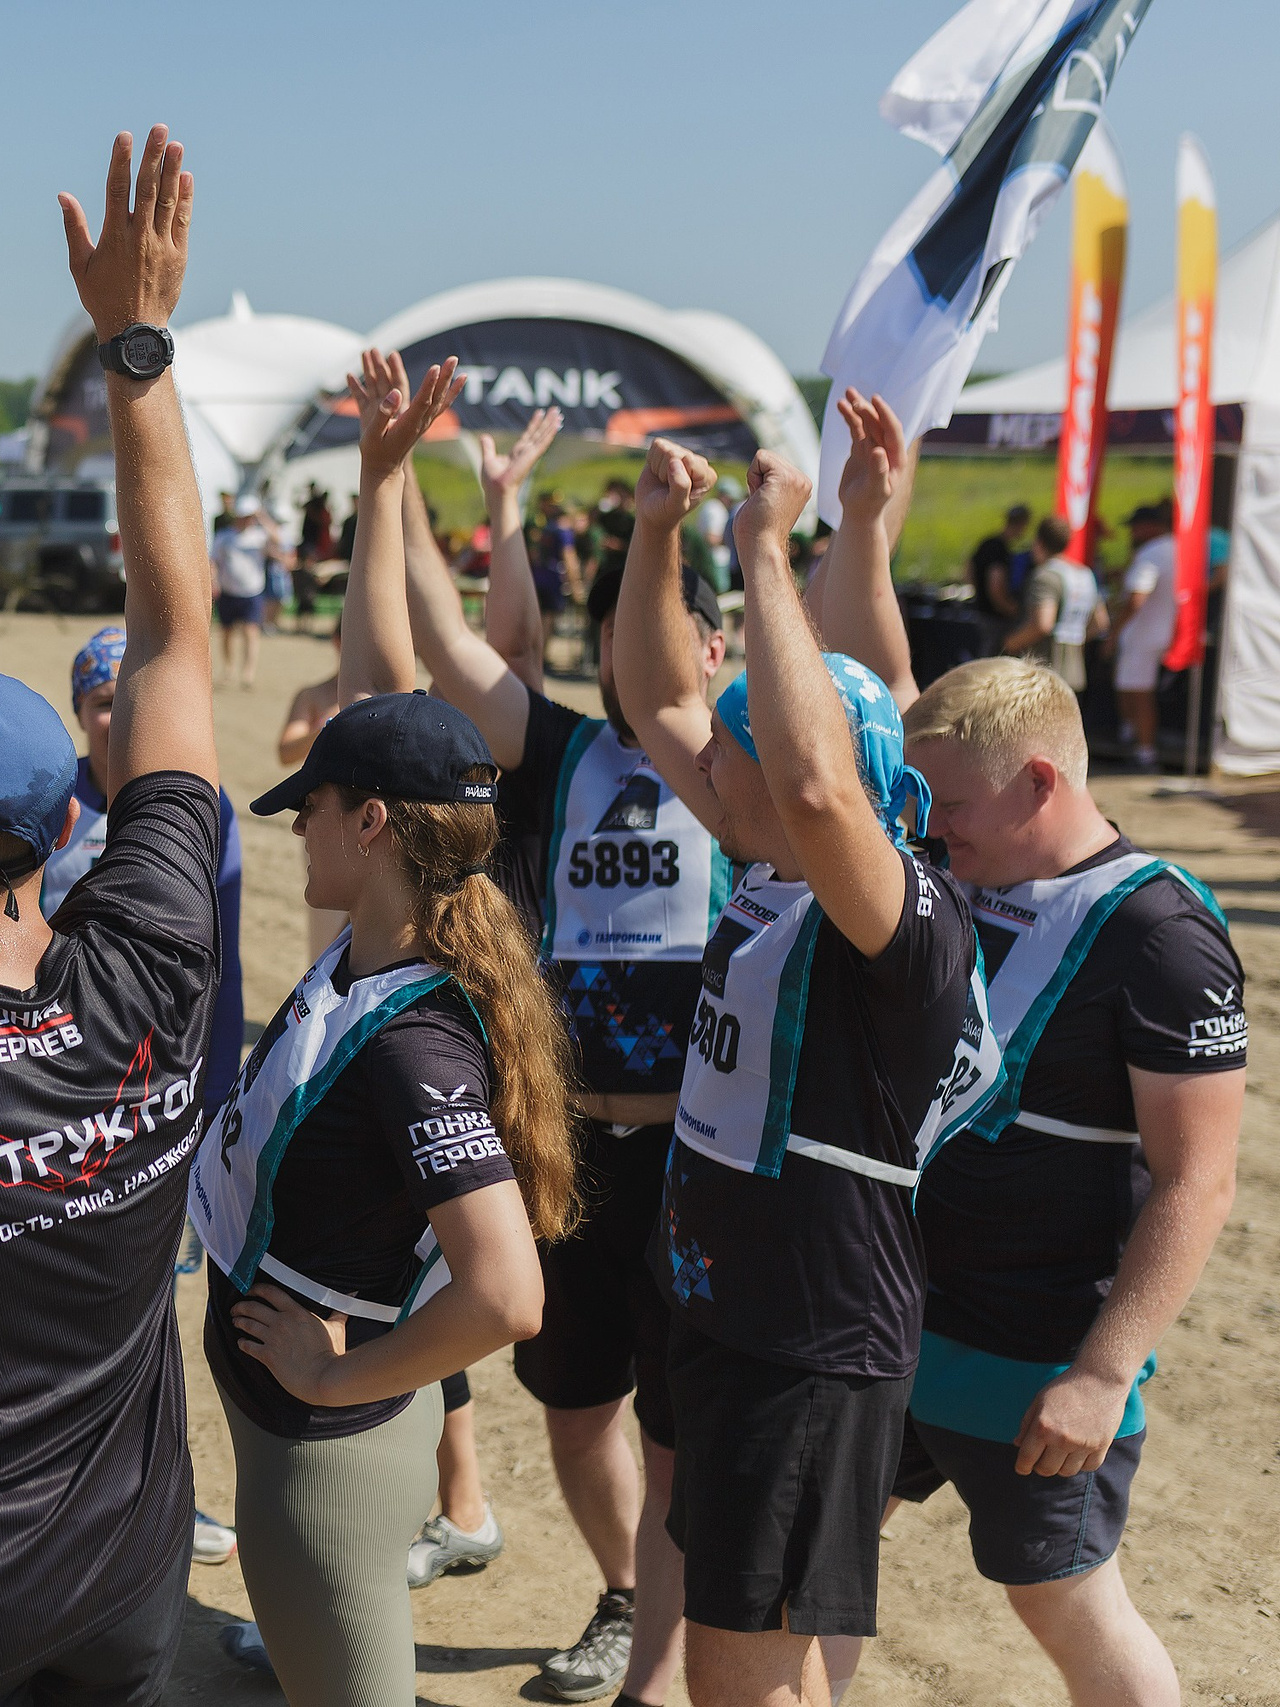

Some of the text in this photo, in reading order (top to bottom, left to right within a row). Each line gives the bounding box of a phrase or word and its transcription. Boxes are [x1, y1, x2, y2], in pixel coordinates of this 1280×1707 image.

[455, 364, 624, 410] TANK
[568, 841, 680, 889] 5893
[734, 893, 780, 923] ГЕРОЕВ
[993, 899, 1038, 922] ГЕРОЕВ
[595, 932, 662, 944] ГАЗПРОМБАНК
[407, 1111, 493, 1146] ГОНКА
[415, 1136, 507, 1181] ГЕРОЕВ
[65, 1187, 116, 1220] СИЛА
